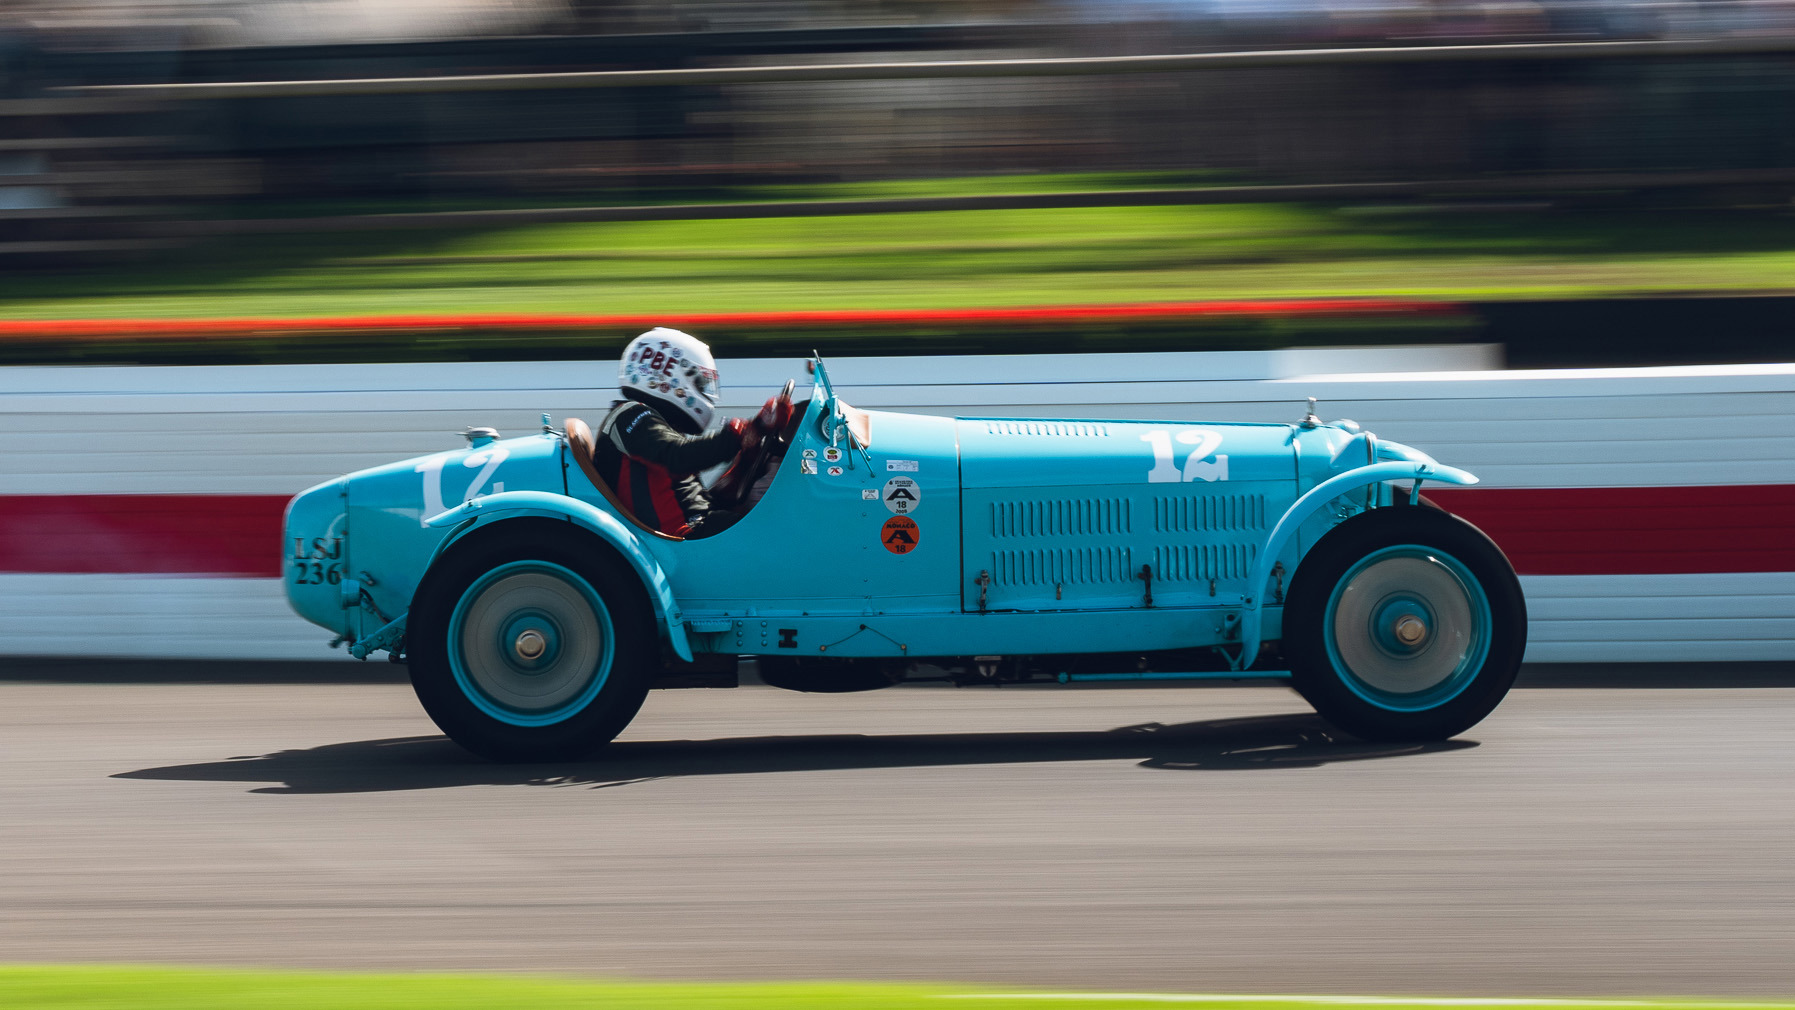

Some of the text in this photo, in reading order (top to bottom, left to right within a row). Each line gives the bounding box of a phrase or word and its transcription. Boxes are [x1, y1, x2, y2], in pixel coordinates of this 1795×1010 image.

[639, 347, 679, 376] PBE
[1140, 429, 1228, 482] 12
[414, 449, 509, 528] 12
[886, 488, 917, 500] A
[294, 537, 344, 560] LSJ
[294, 562, 342, 585] 236
